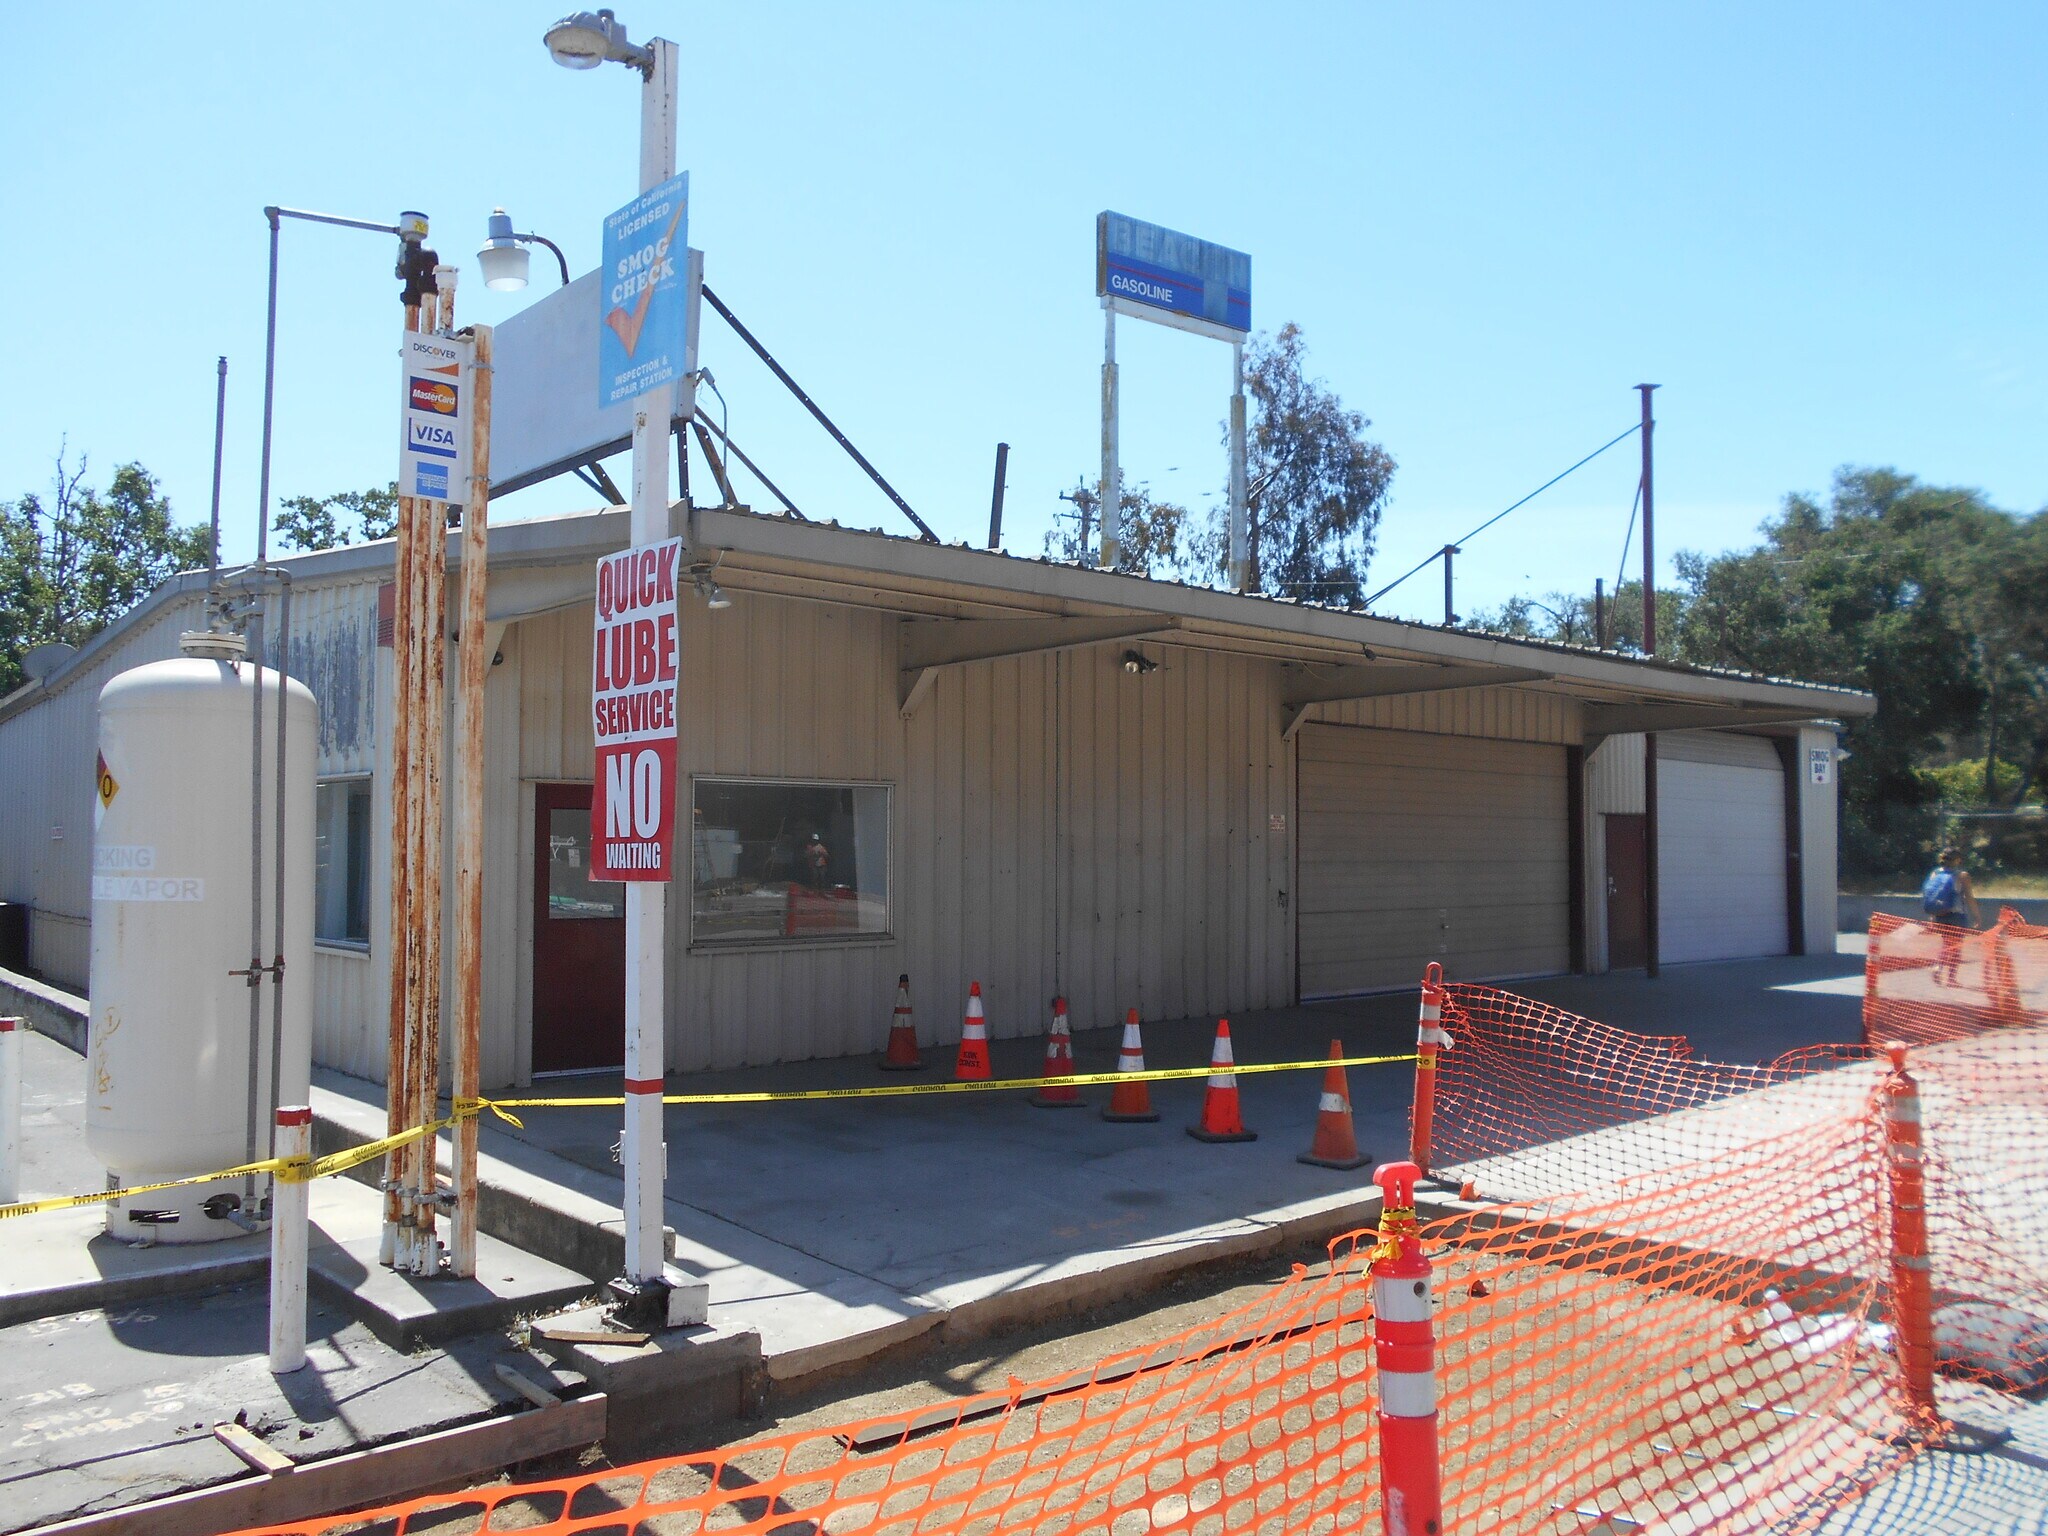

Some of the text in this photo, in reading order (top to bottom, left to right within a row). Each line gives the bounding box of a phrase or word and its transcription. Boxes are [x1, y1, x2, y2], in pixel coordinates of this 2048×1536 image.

[608, 180, 682, 228] State of California
[618, 202, 670, 240] LICENSED
[617, 236, 669, 279] SMOG
[611, 257, 675, 303] CHECK
[1112, 274, 1173, 303] GASOLINE
[413, 343, 456, 359] DISCOVER
[610, 366, 673, 401] REPAIR STATION
[615, 355, 669, 386] INSPECTION &
[412, 388, 456, 405] MasterCard
[416, 423, 455, 446] VISA
[598, 542, 678, 622] QUICK
[595, 613, 677, 692] LUBE
[595, 689, 674, 737] SERVICE
[605, 749, 662, 839] NO
[605, 841, 661, 870] WAITING
[118, 879, 199, 899] VAPOR
